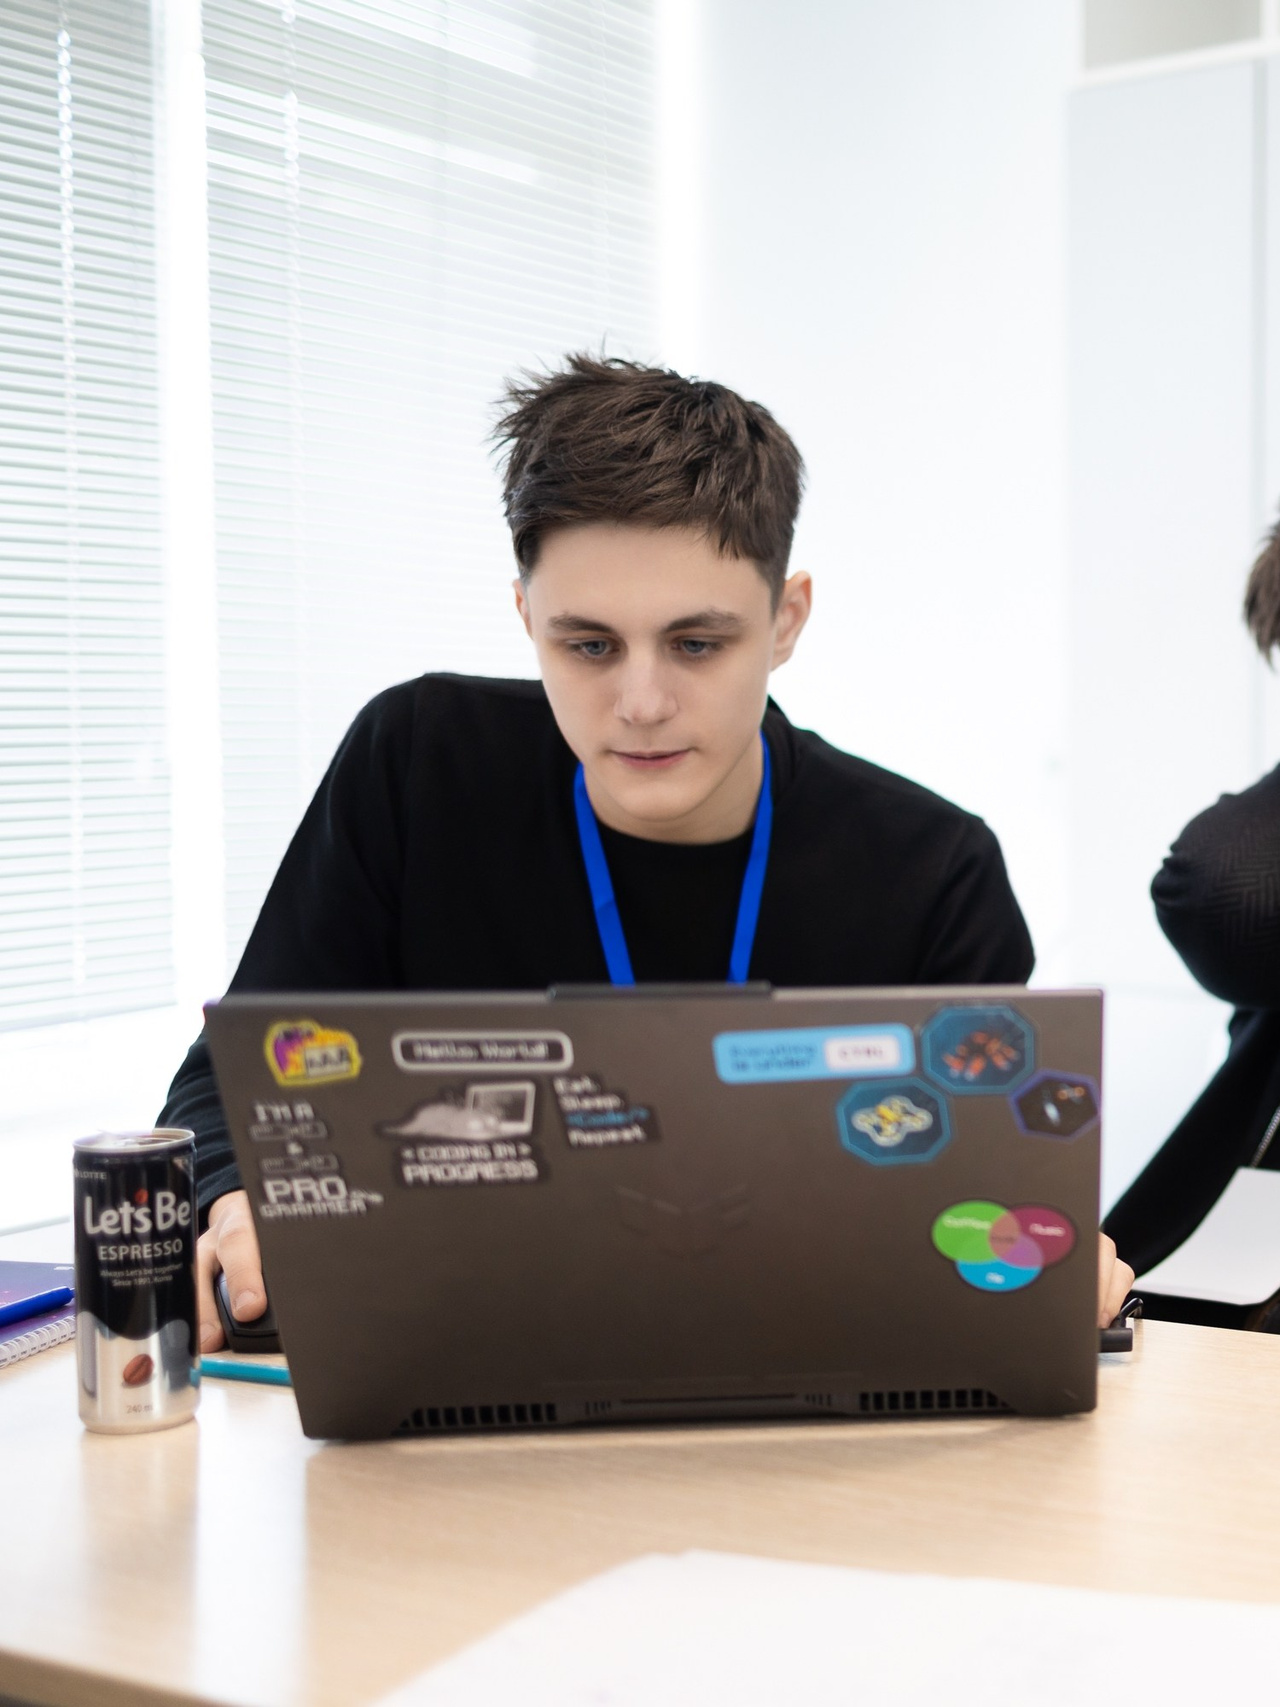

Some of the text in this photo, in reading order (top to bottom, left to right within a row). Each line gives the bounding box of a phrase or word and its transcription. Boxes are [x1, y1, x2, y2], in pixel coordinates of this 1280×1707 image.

[402, 1160, 539, 1184] PROGRESS
[263, 1176, 349, 1203] PRO
[155, 1191, 191, 1231] Be
[99, 1238, 183, 1260] ESPRESSO
